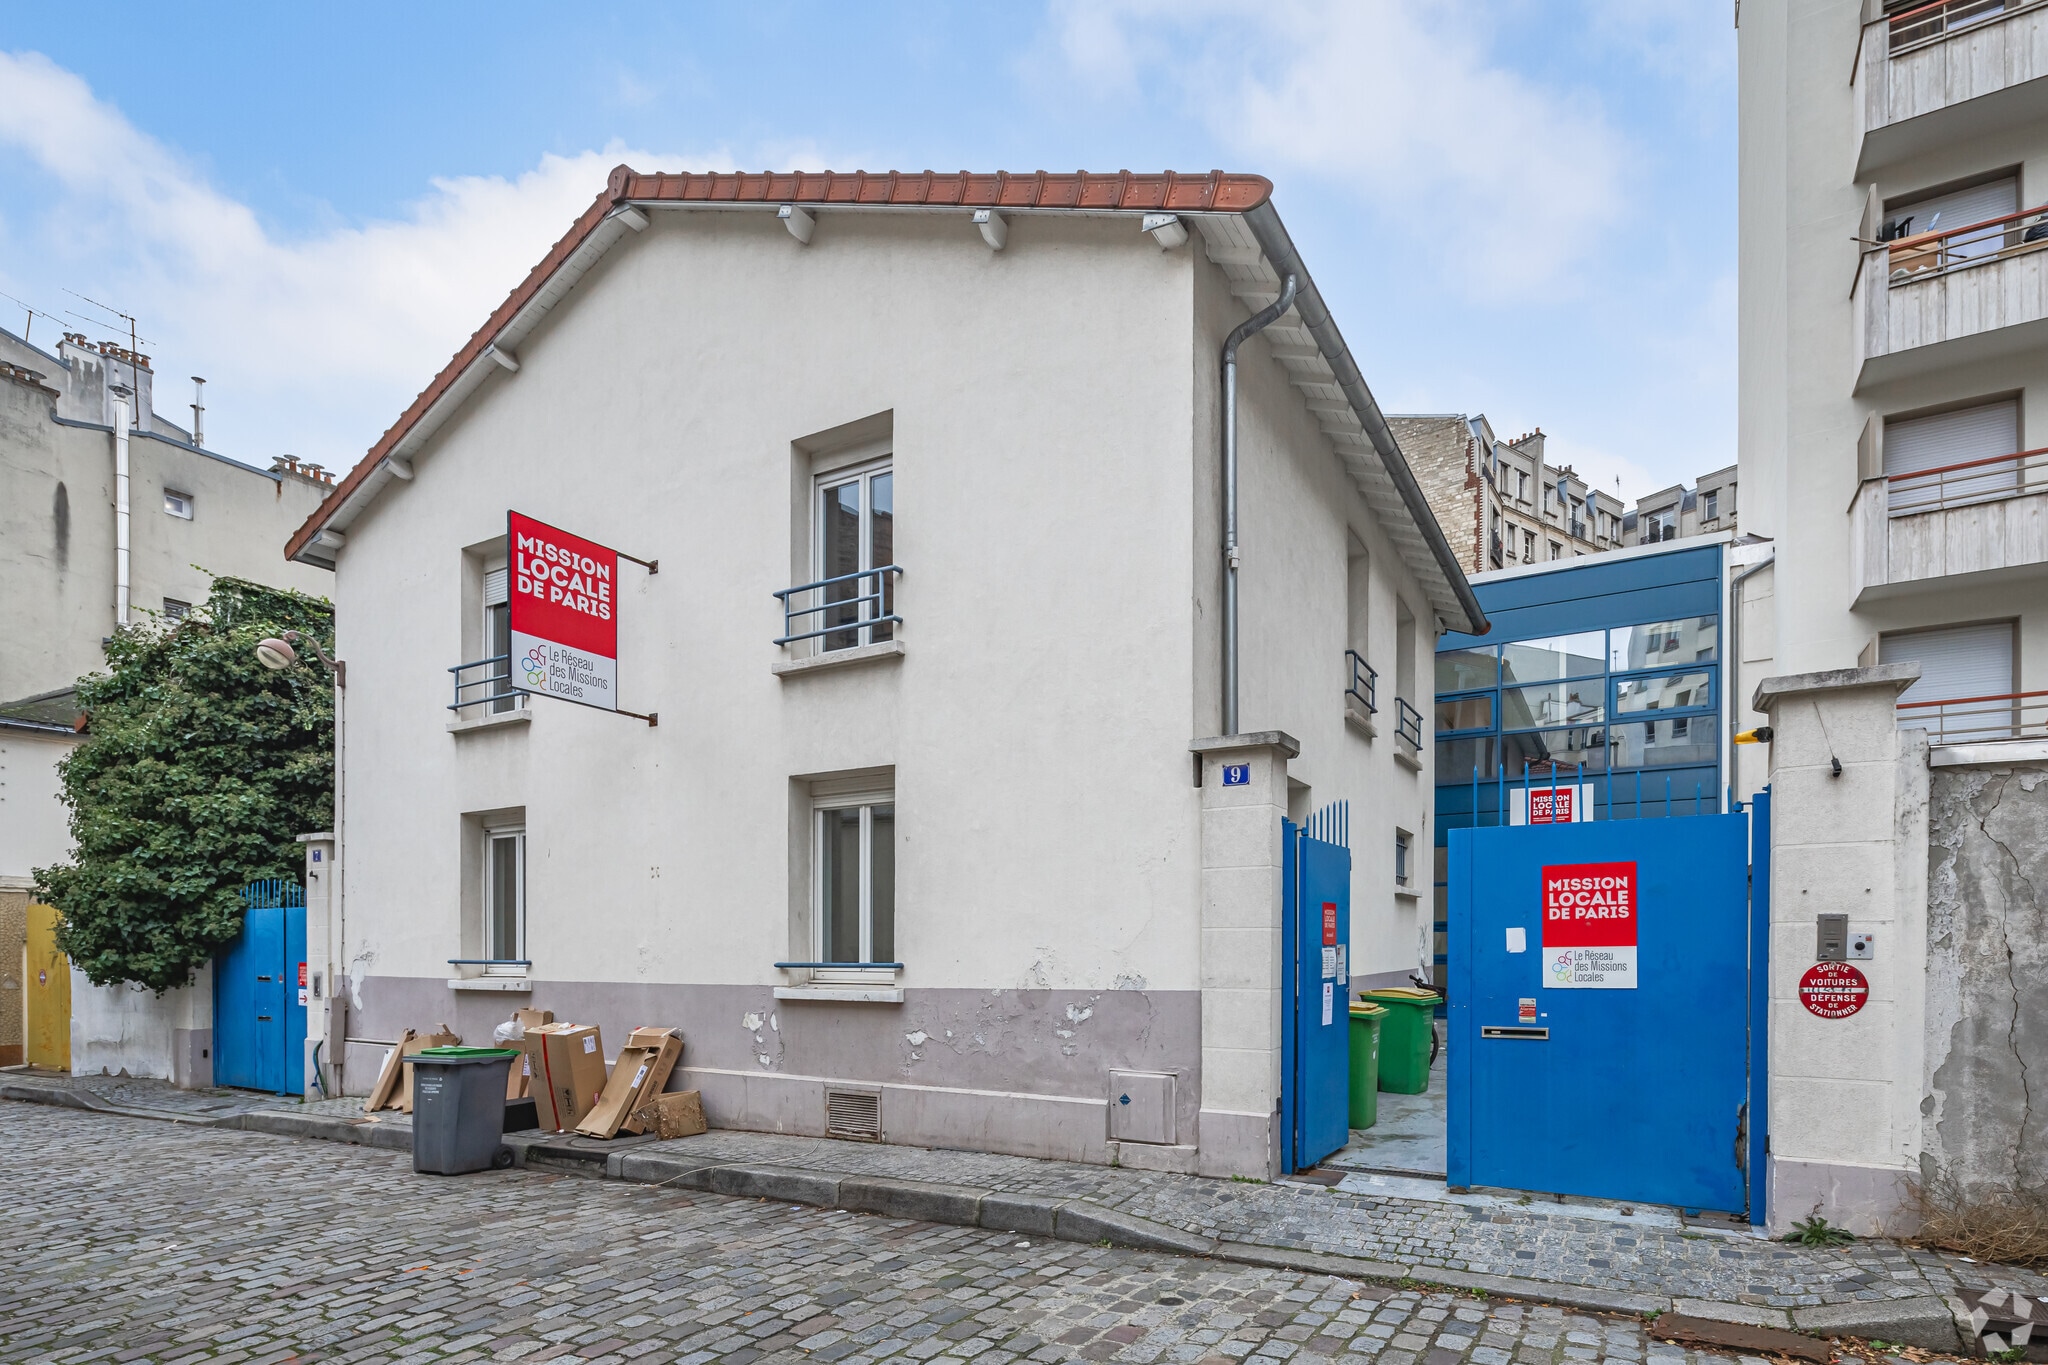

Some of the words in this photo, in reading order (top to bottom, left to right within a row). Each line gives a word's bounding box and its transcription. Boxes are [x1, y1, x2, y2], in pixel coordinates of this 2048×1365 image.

[518, 532, 610, 582] MISSION
[518, 552, 610, 603] LOCALE
[518, 574, 544, 599] DE
[550, 586, 610, 620] PARIS
[549, 646, 559, 662] Le
[562, 649, 594, 672] Réseau
[550, 663, 566, 679] des
[568, 667, 608, 690] Missions
[549, 679, 583, 698] Locales
[1230, 766, 1241, 783] 9
[1549, 876, 1628, 891] MISSION
[1549, 890, 1628, 907] LOCALE
[1549, 908, 1570, 920] DE
[1575, 906, 1629, 919] PARIS
[1575, 950, 1583, 960] Le
[1585, 950, 1613, 960] Réseau
[1575, 961, 1589, 971] des
[1591, 961, 1627, 971] Missions
[1817, 964, 1850, 973] SORTIE
[1575, 972, 1604, 982] Locales
[1810, 1003, 1858, 1016] STATIONNER
